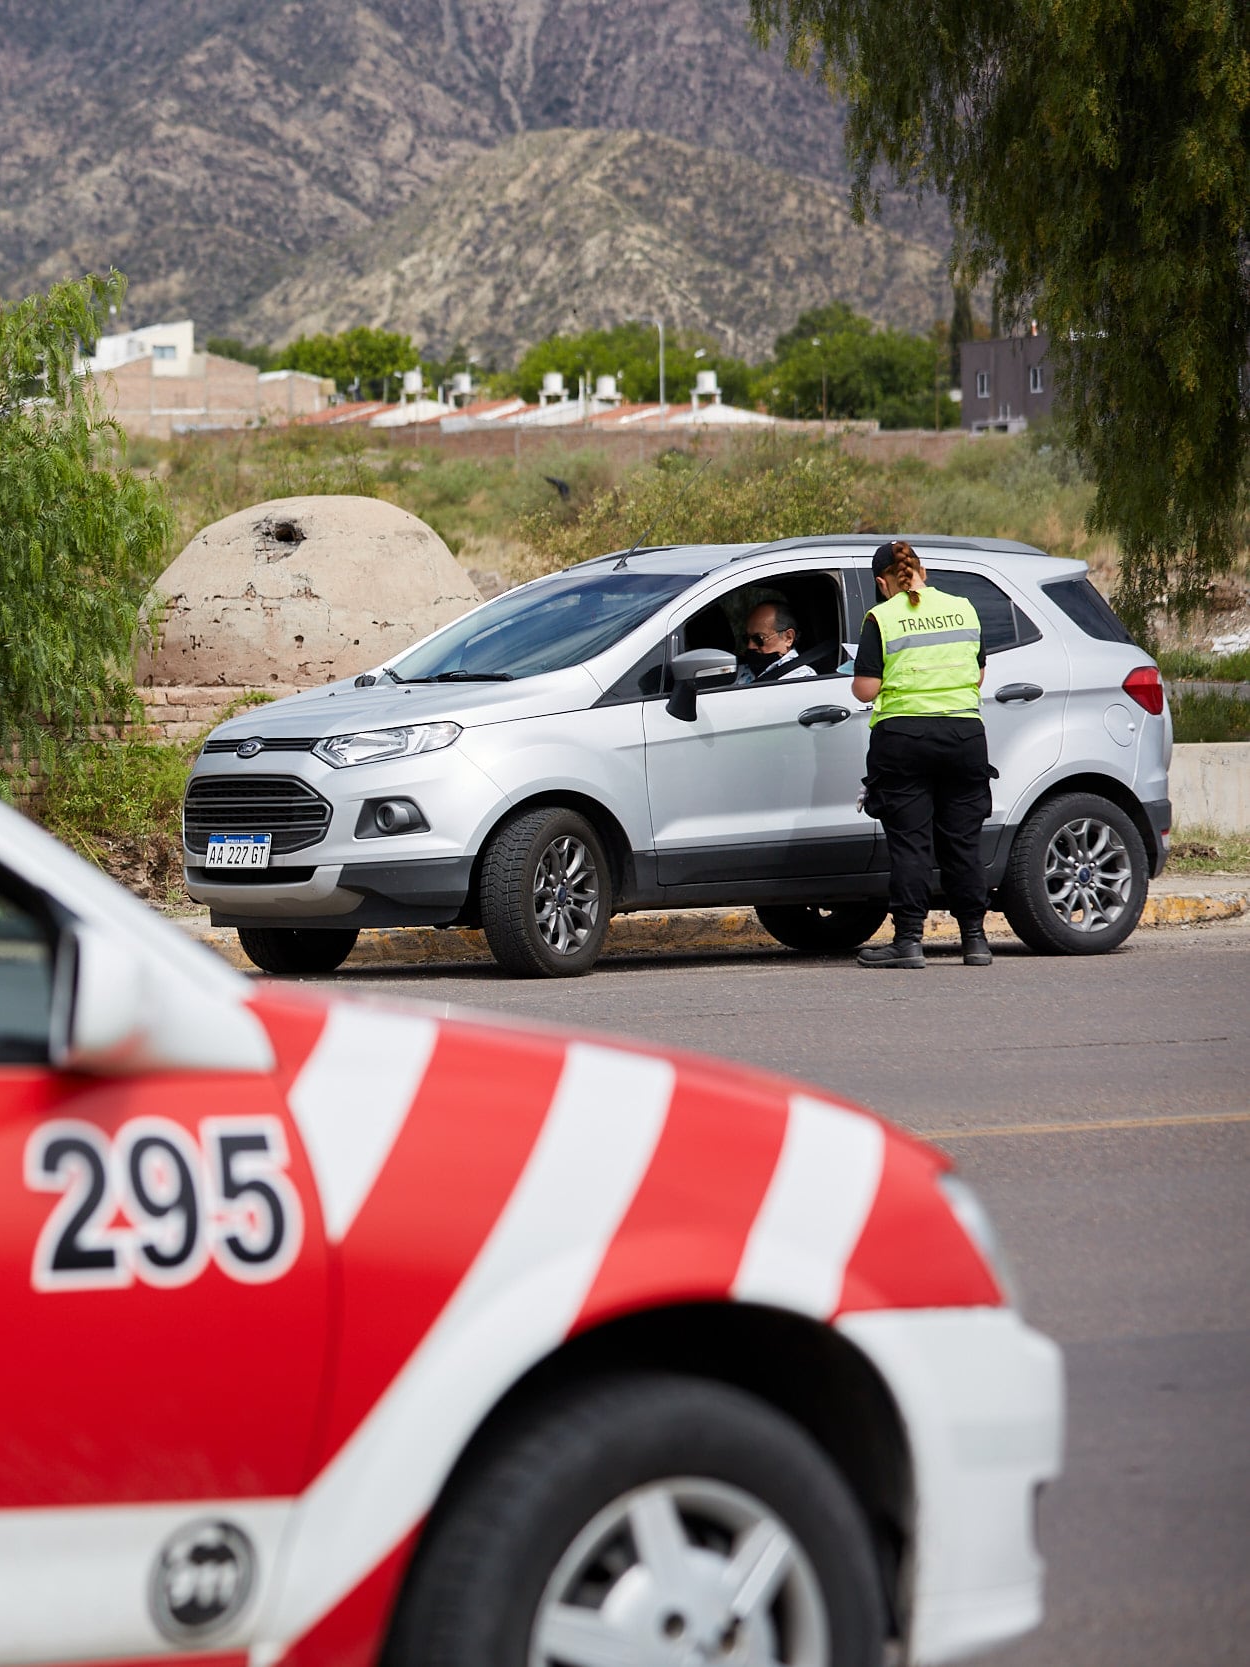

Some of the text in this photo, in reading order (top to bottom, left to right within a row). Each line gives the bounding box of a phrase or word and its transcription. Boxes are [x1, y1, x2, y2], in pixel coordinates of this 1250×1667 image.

[898, 613, 964, 632] TRANSITO
[209, 846, 265, 864] AA 227 GT
[27, 1117, 302, 1290] 295
